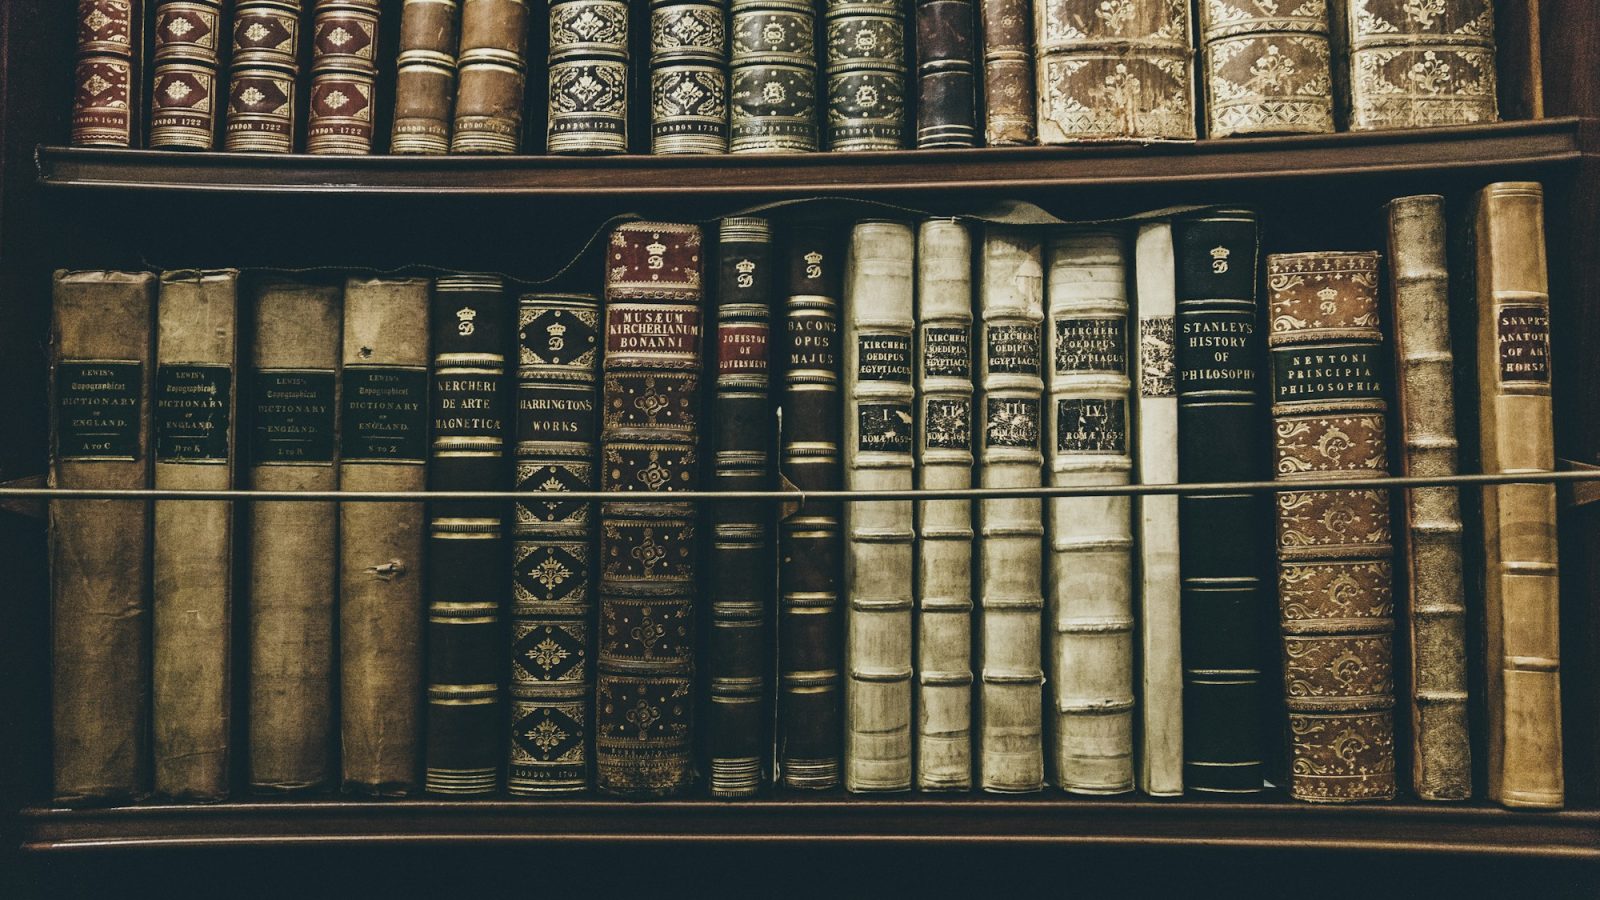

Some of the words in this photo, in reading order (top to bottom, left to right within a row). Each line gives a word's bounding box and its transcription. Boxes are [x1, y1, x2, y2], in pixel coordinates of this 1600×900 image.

[181, 118, 202, 126] 1722
[260, 123, 281, 131] 1722
[340, 127, 362, 135] 1722
[657, 124, 692, 133] LONDON
[610, 323, 698, 336] KIRCHERIANUM
[1064, 327, 1118, 336] KIRCHERI
[1183, 321, 1253, 335] STANLEY'S
[620, 336, 683, 348] BONANNI
[723, 334, 766, 344] JOHNSTON
[795, 336, 829, 347] OPUS
[928, 334, 968, 342] KIRCHERI
[1189, 336, 1247, 348] HISTORY
[864, 340, 908, 350] KIRCHERI
[1068, 340, 1116, 349] OEDIPUS
[739, 346, 751, 355] ON
[1508, 347, 1523, 357] OF
[1530, 347, 1544, 356] AN
[791, 353, 833, 364] MAJUS
[866, 352, 905, 362] OEDIPUS
[1214, 352, 1230, 362] OF
[1293, 354, 1367, 366] NEWTONI
[1506, 362, 1545, 372] HORSE
[1181, 368, 1256, 381] PHILOSOPHY
[1288, 368, 1372, 380] PRINCIPIA
[62, 398, 137, 406] DICTIONARY
[158, 400, 224, 408] DICTIONARY
[350, 402, 419, 411] DICTIONARY
[442, 398, 456, 409] DE
[461, 398, 490, 409] ARTE
[533, 421, 578, 432] WORKS
